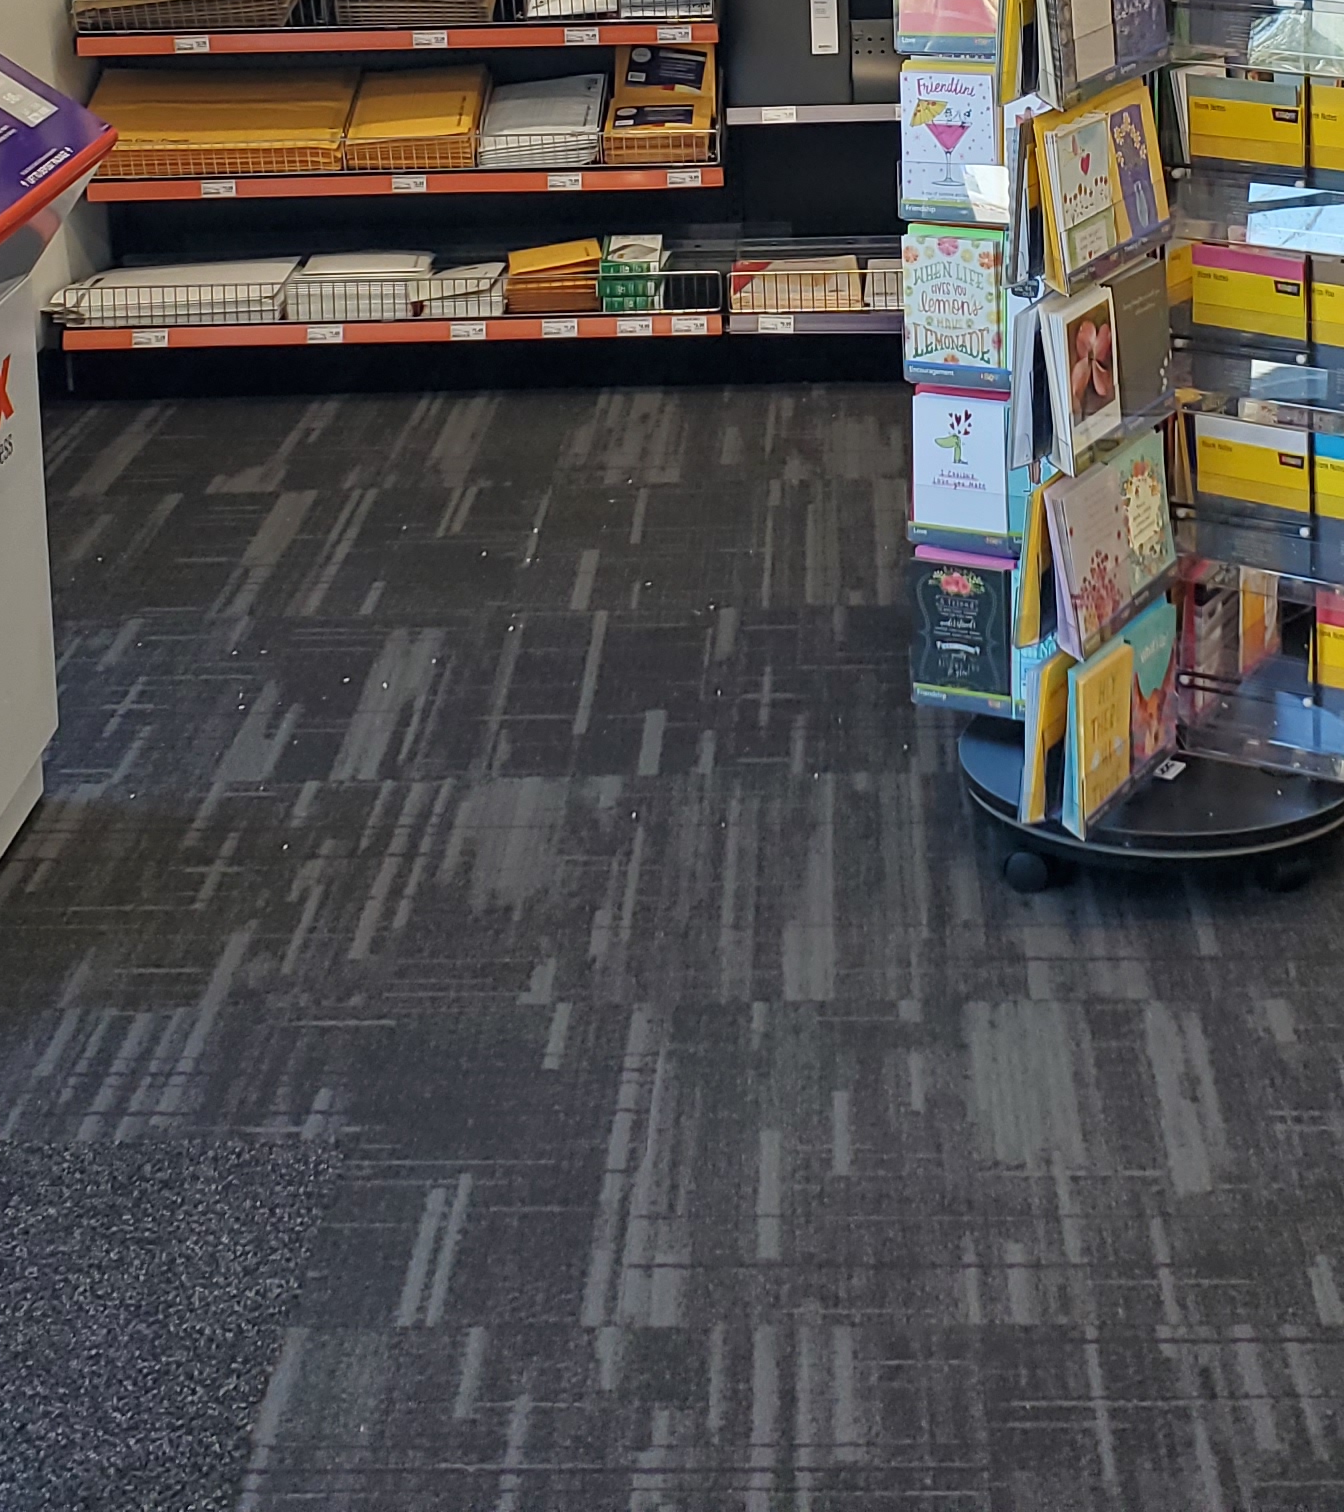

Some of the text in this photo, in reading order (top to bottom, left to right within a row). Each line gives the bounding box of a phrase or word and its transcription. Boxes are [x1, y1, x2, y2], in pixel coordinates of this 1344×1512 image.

[905, 205, 935, 213] Friendship
[913, 261, 984, 289] WHEN LIFE
[931, 283, 967, 296] GIVES YOU
[912, 322, 990, 364] LEMONADE
[909, 366, 954, 376] Encouragement
